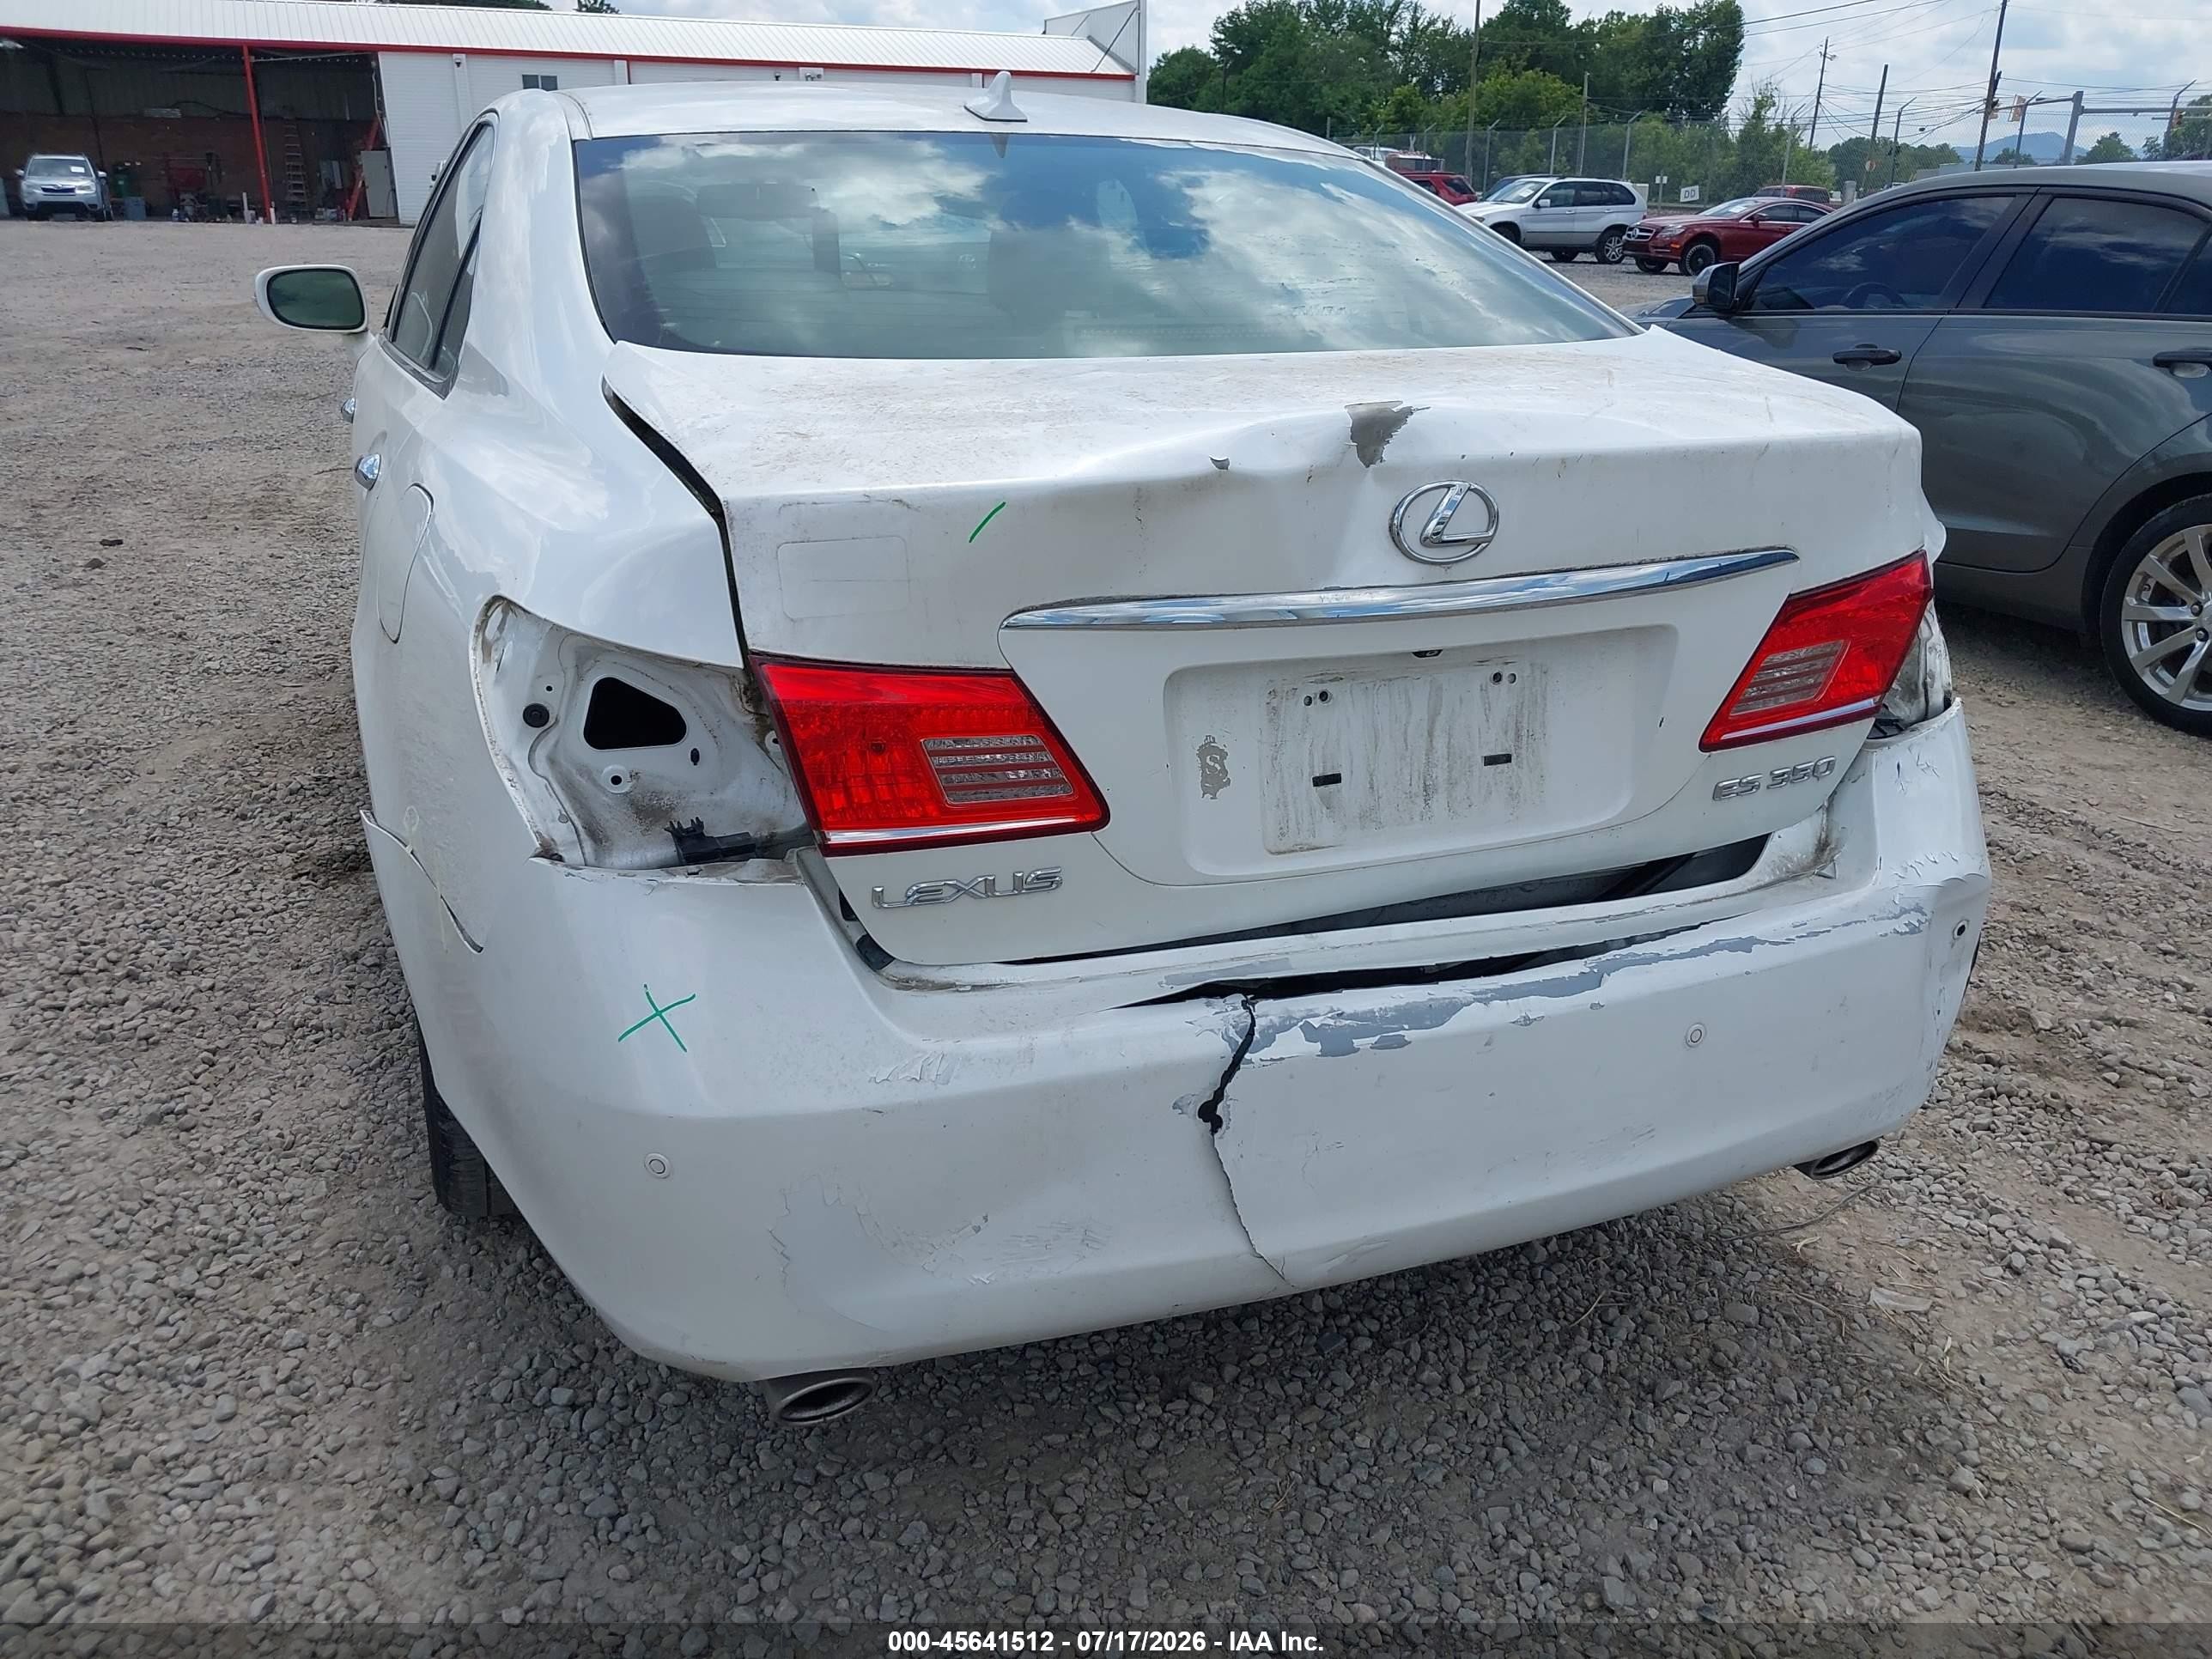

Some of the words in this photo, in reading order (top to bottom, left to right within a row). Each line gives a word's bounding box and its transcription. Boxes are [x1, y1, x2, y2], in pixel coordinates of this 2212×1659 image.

[1712, 774, 1763, 801] ES
[1766, 756, 1836, 790] 350
[872, 866, 1063, 909] LEXUS
